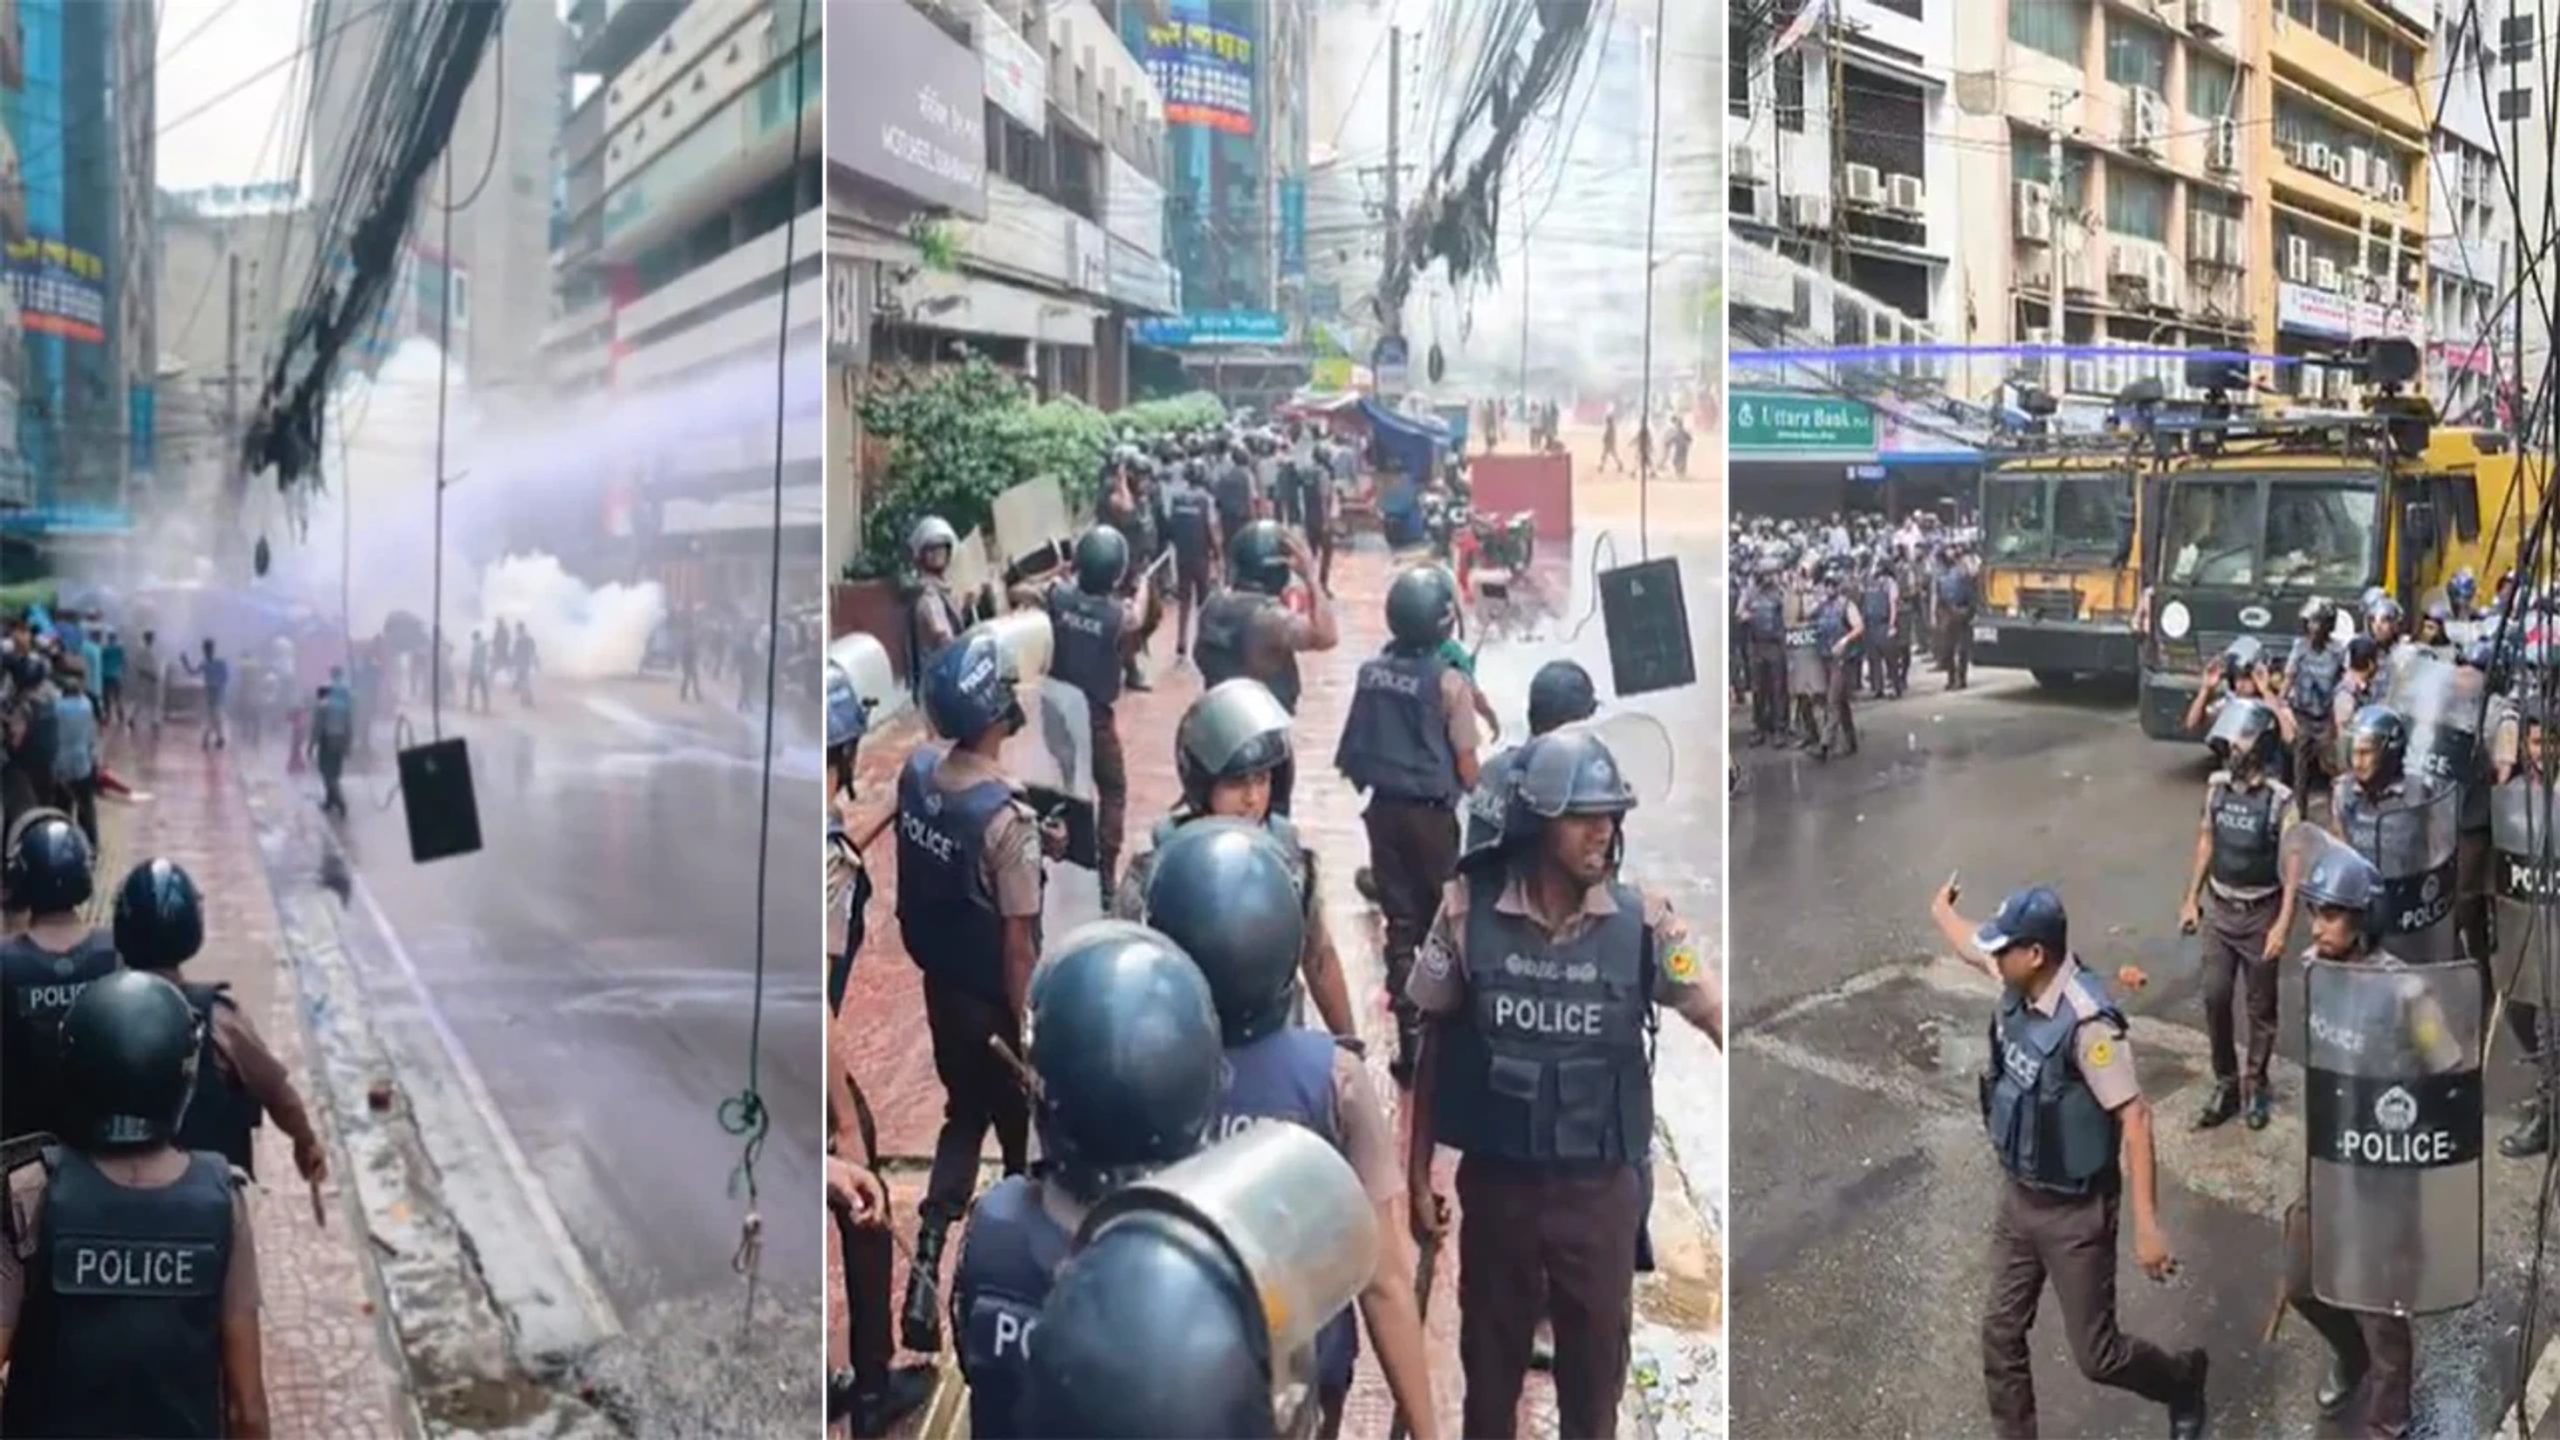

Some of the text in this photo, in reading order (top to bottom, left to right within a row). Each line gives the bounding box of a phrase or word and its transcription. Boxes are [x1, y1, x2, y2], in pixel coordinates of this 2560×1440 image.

[1813, 405, 1850, 428] Bank
[1062, 611, 1103, 636] POLICE
[1369, 666, 1419, 695] POLICE
[903, 811, 952, 862] POLICE
[2216, 812, 2257, 832] POLICE
[1496, 995, 1602, 1035] POLICE
[2344, 1129, 2449, 1163] POLICE
[76, 1249, 193, 1285] POLICE
